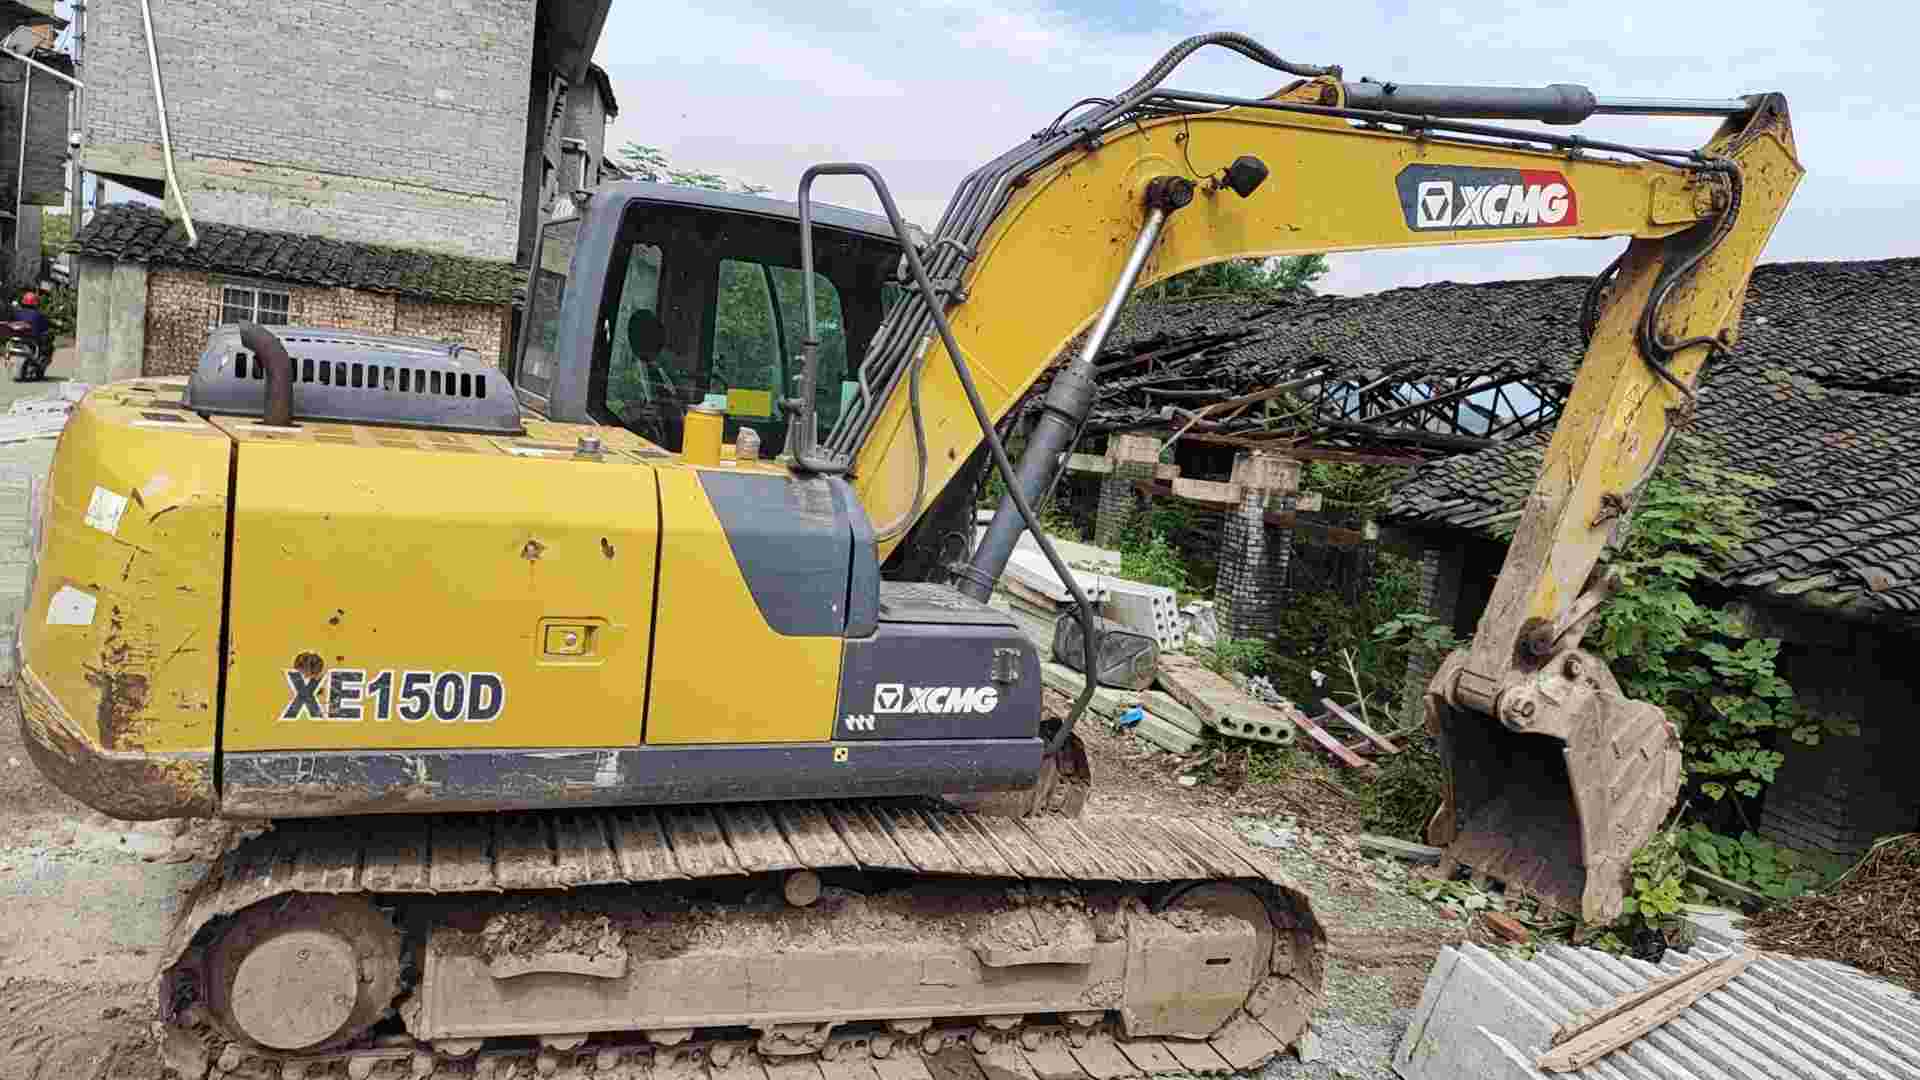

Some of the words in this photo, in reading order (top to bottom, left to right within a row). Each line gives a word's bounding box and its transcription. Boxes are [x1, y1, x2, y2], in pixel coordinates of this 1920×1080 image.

[1452, 183, 1568, 226] XCMG
[281, 669, 504, 721] XE150D
[903, 686, 998, 713] XCMG
